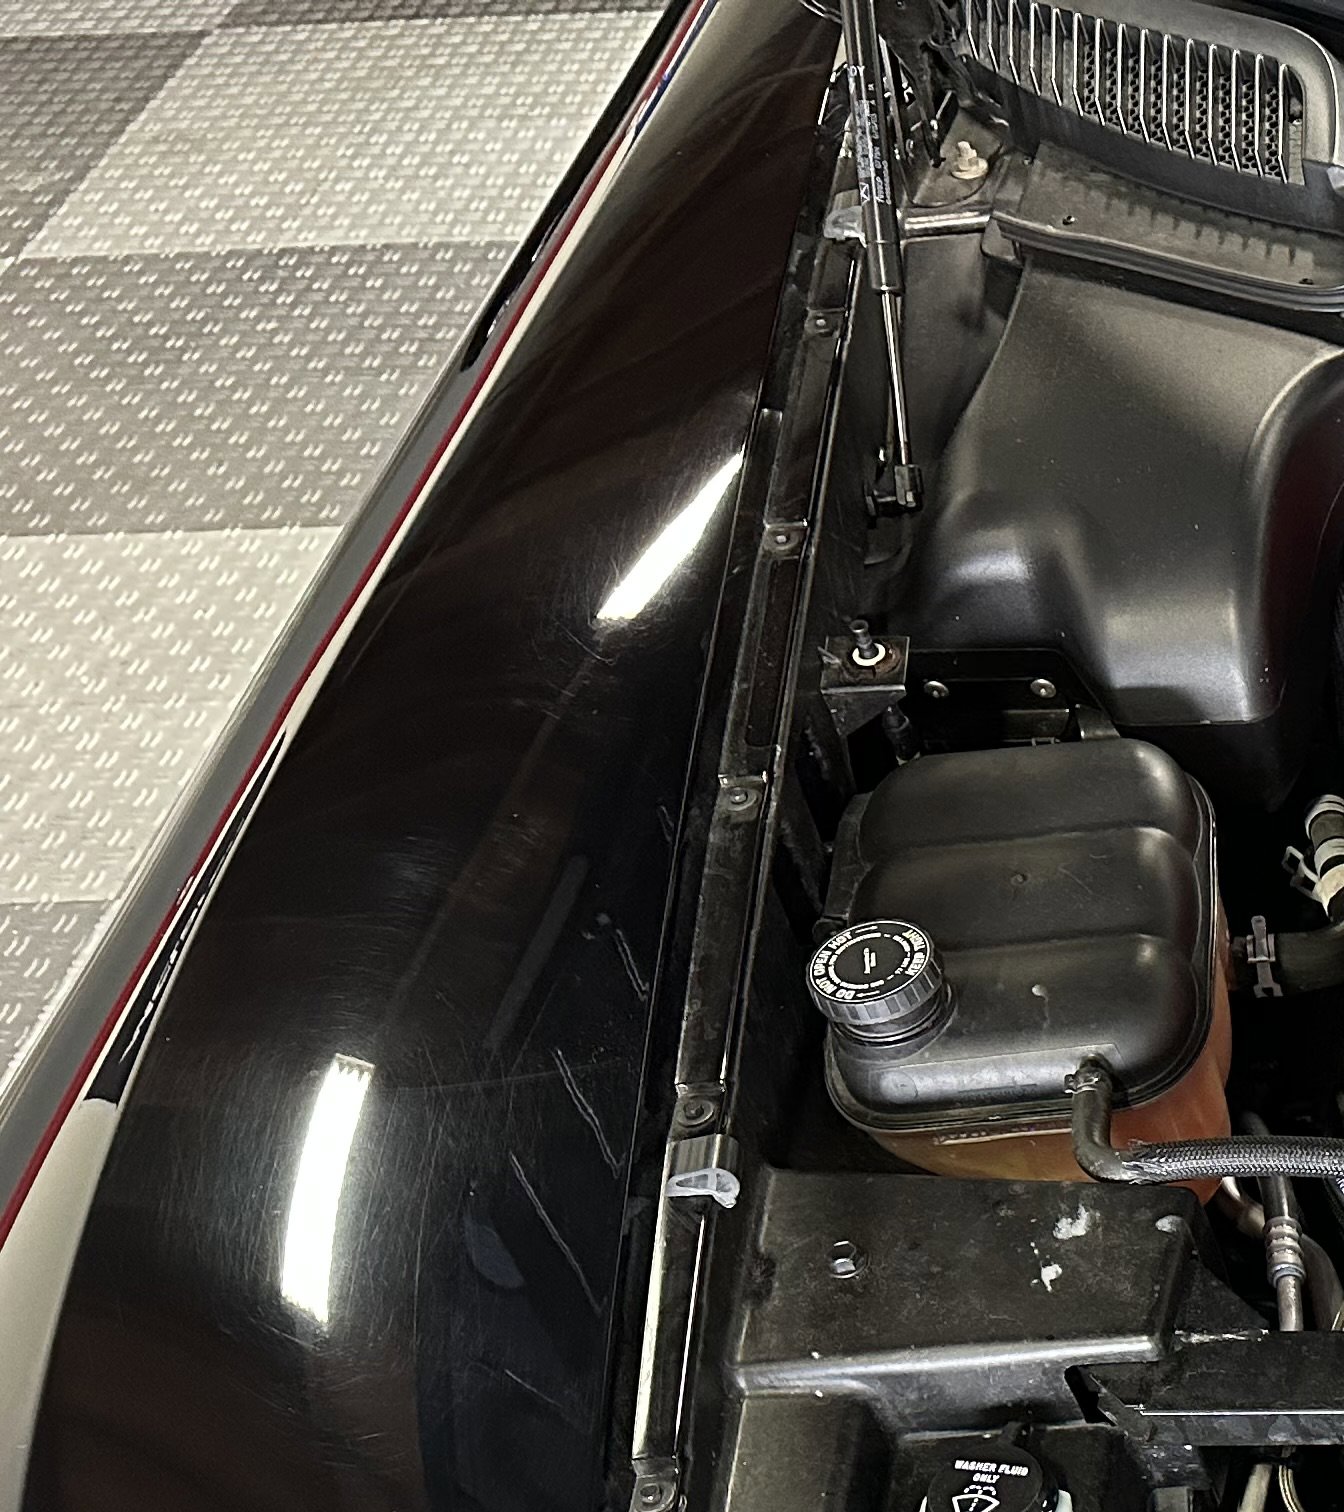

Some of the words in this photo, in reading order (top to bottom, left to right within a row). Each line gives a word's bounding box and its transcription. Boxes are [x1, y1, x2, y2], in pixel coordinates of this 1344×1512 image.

[828, 932, 852, 950] HOT
[814, 950, 832, 976] OPEN
[905, 952, 925, 976] KEEP
[816, 978, 837, 994] NOT
[836, 990, 856, 1000] DO
[954, 1460, 997, 1473] WASHER
[998, 1463, 1029, 1477] FLUID
[973, 1473, 1000, 1484] ONLY
